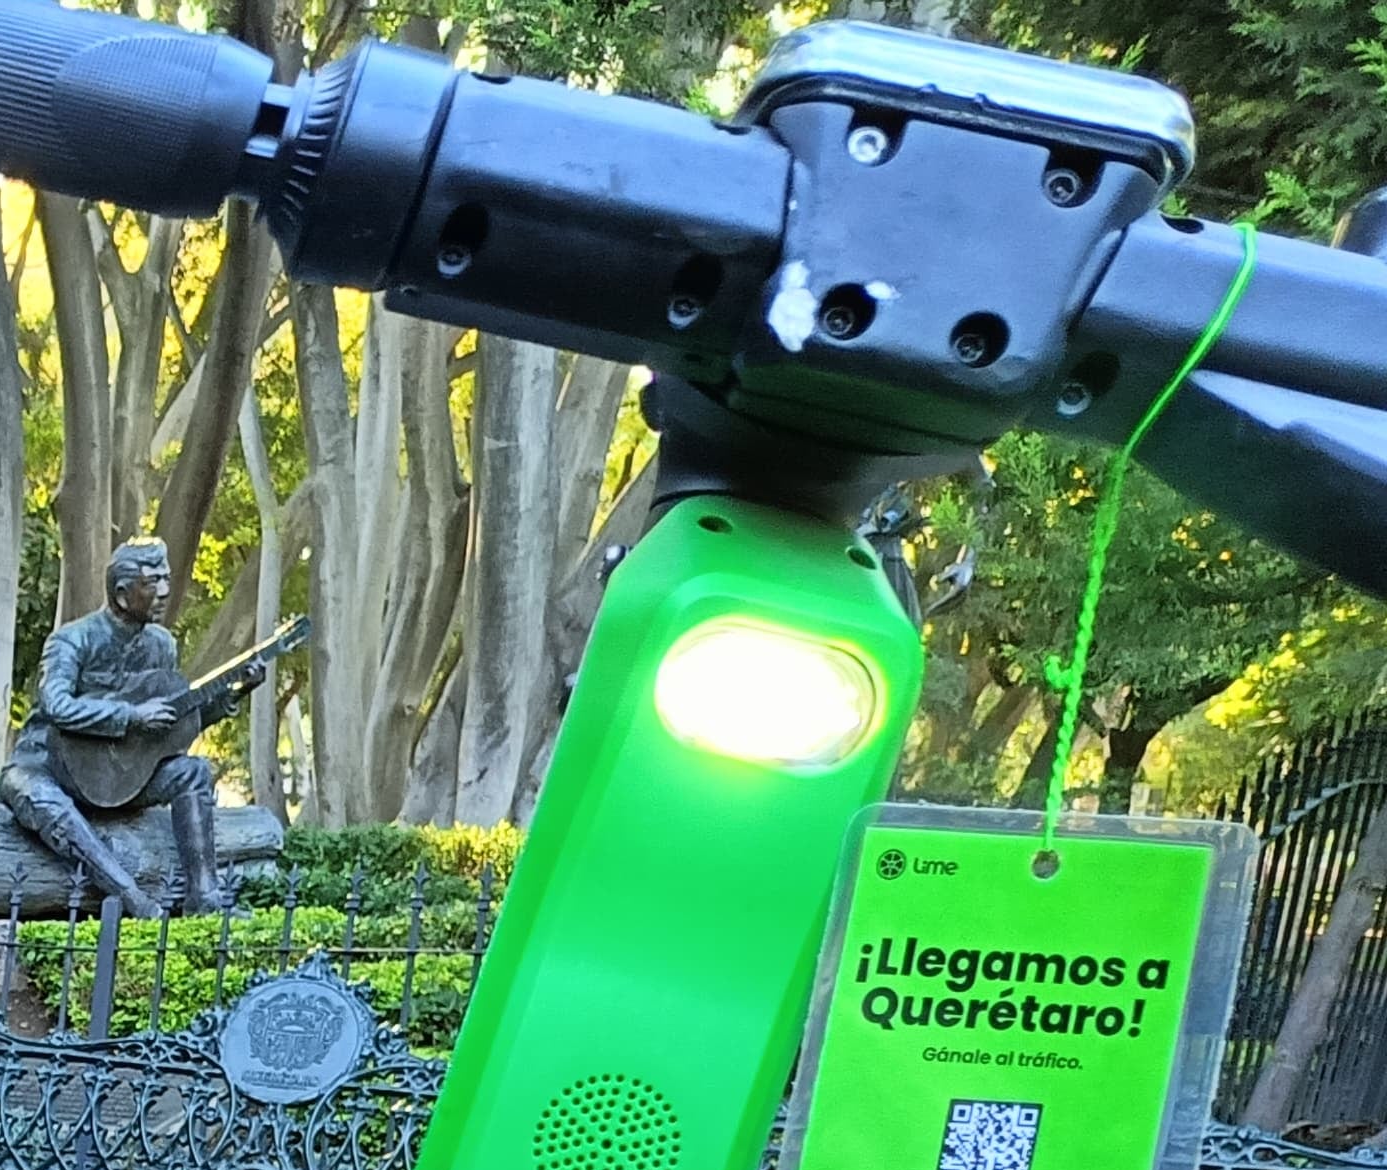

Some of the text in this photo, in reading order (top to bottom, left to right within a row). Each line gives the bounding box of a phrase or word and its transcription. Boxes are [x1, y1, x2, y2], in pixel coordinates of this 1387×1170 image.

[913, 857, 959, 876] Lime
[855, 937, 1171, 993] ¡Llegamos a
[861, 986, 1147, 1038] Querétaro!
[922, 1046, 1084, 1071] Gánale al tráfico.
